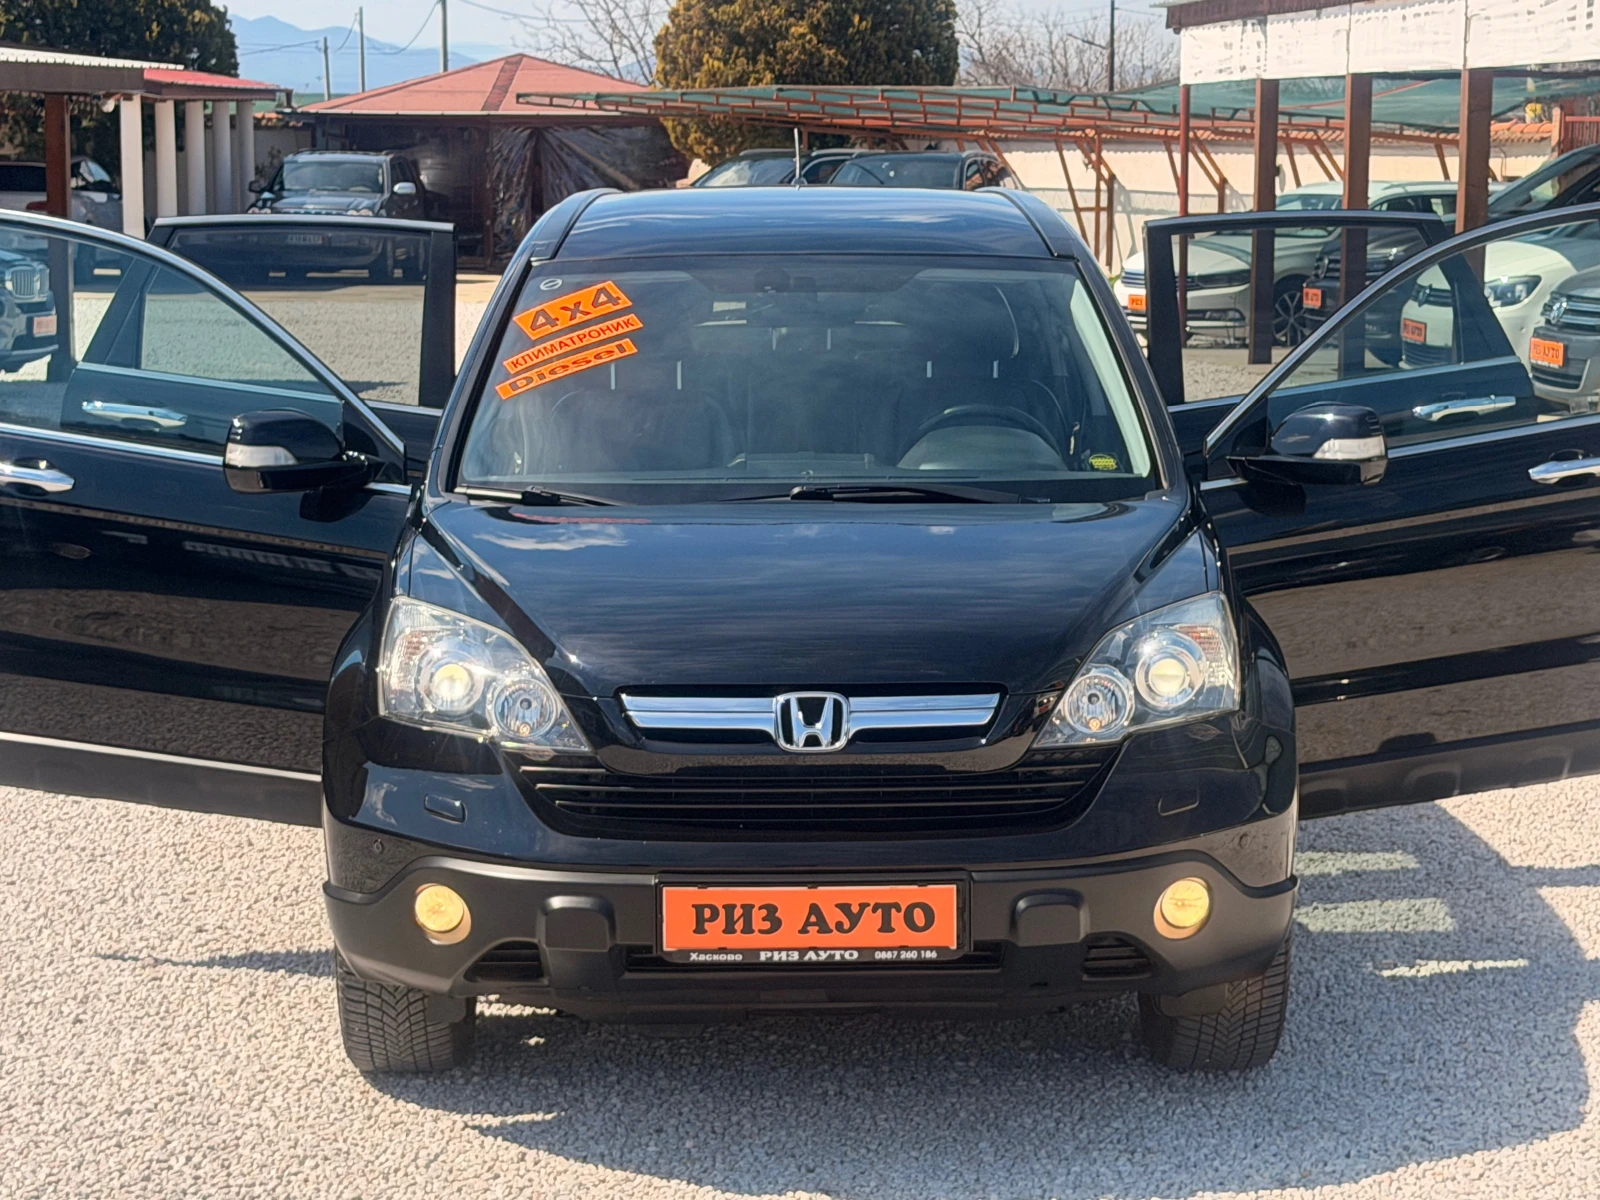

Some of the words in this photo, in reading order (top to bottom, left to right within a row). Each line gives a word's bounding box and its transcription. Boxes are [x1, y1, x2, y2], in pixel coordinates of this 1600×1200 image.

[511, 318, 635, 369] КЛИМАТРОНИК
[509, 343, 627, 391] Diesel
[691, 903, 783, 934] РИЗ
[798, 902, 936, 934] АУТО
[689, 952, 743, 961] Хасково
[760, 950, 799, 961] РИЗ
[803, 950, 859, 961] АУТО
[900, 950, 918, 960] 260
[920, 950, 937, 959] 186
